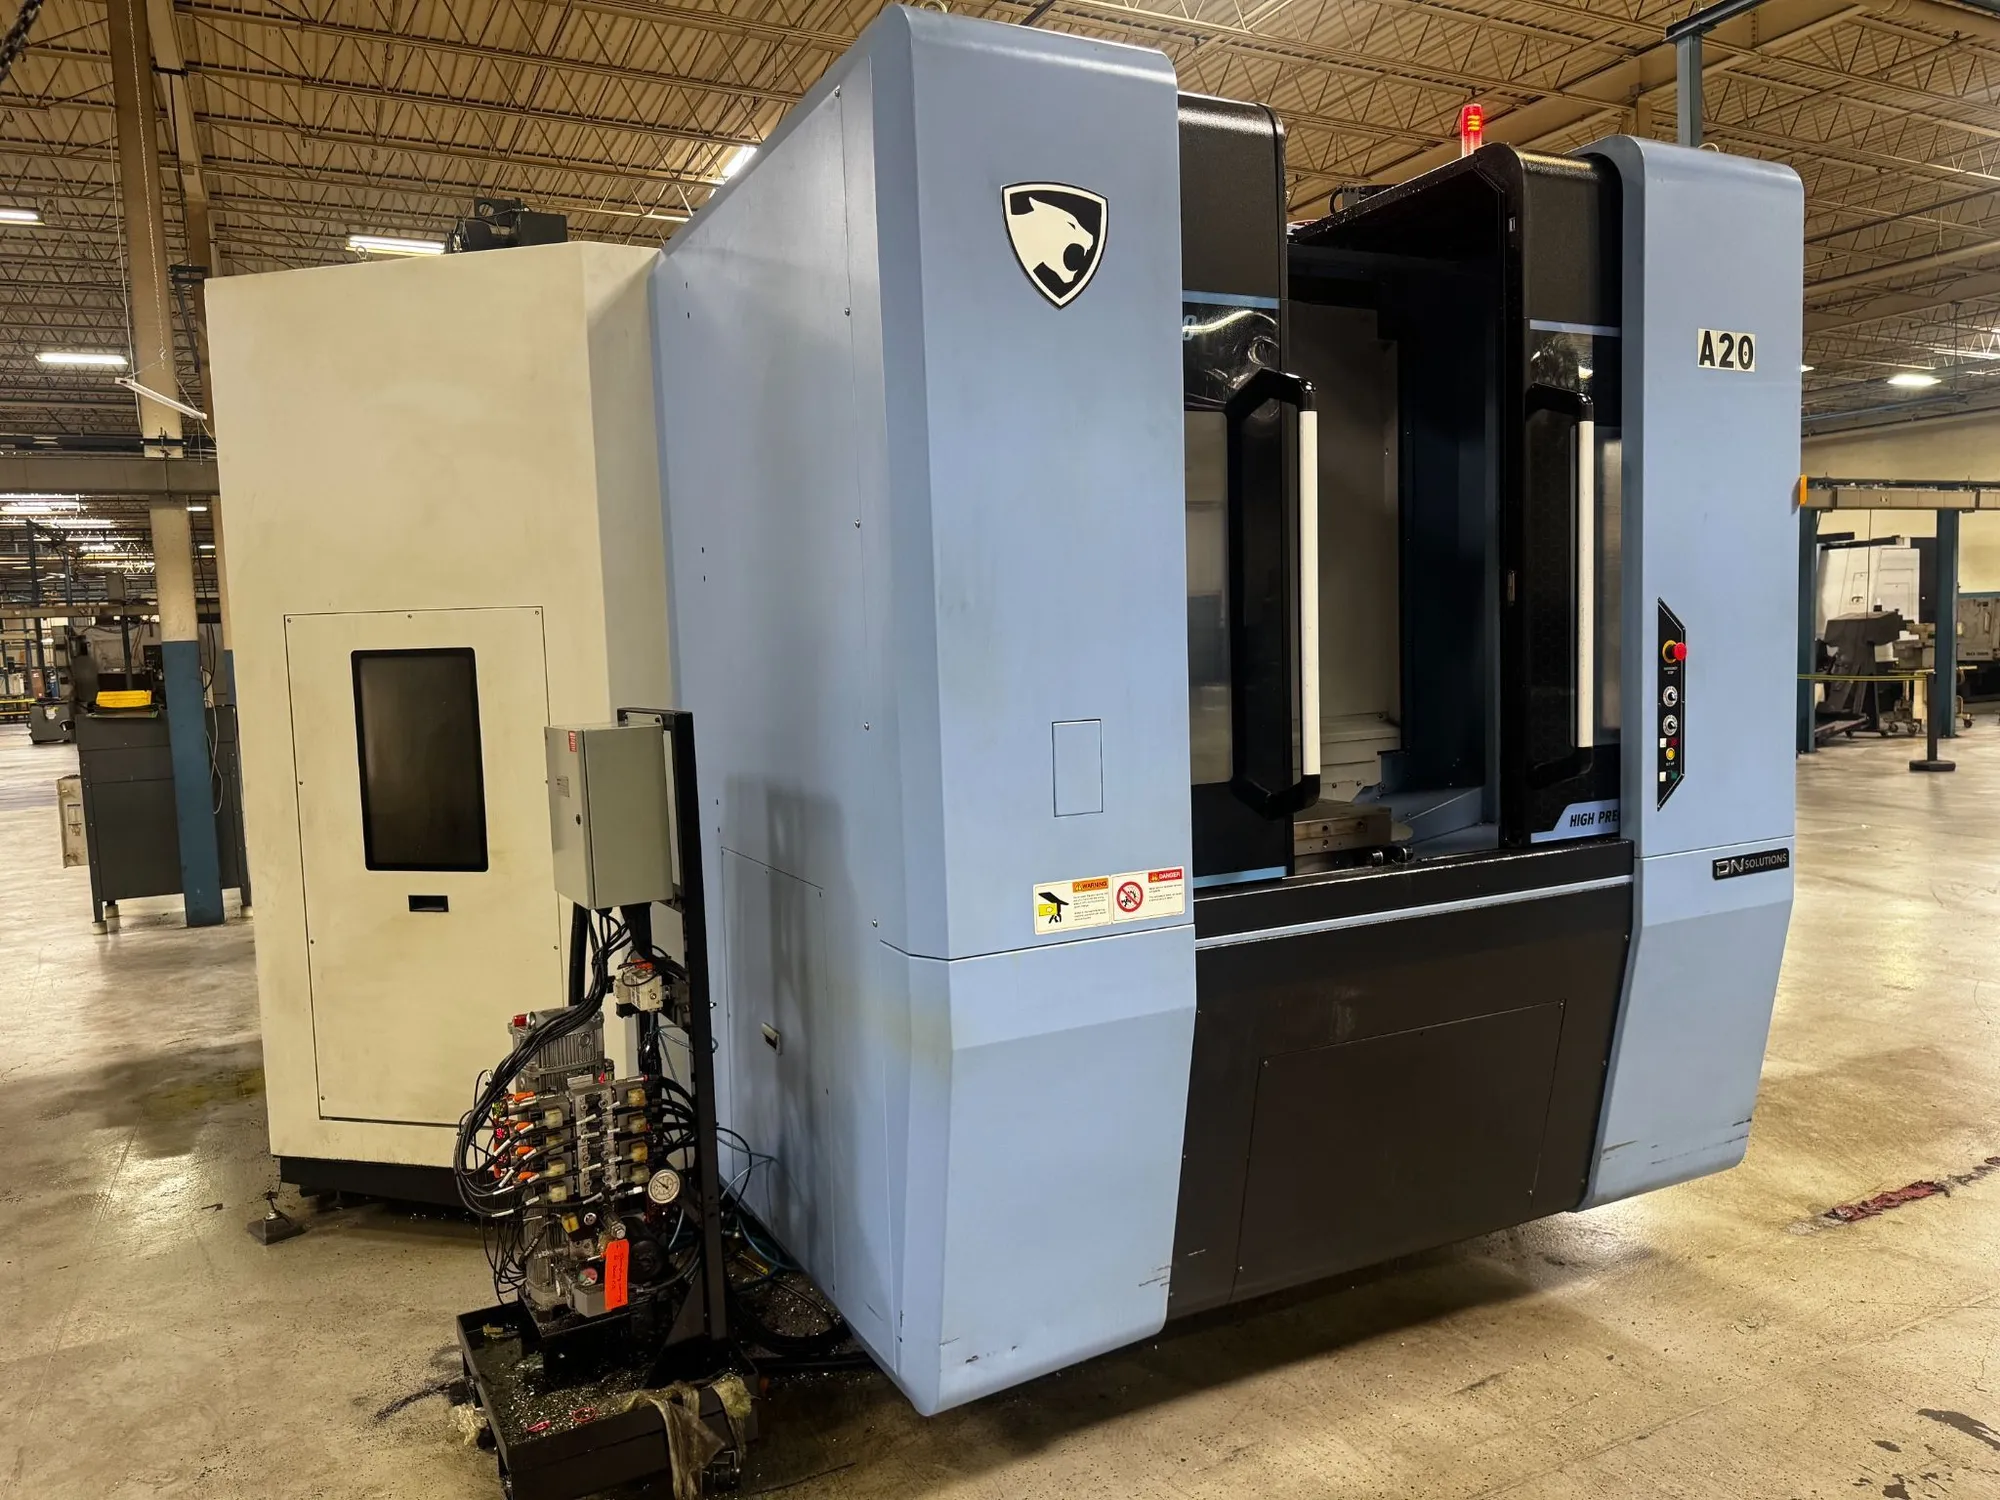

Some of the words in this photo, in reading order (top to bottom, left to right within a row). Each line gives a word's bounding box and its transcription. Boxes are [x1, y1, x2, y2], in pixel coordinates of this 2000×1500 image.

[1699, 330, 1754, 370] A20
[1570, 812, 1595, 828] HIGH
[1716, 858, 1745, 877] DN
[1745, 853, 1787, 869] SOLUTIONS
[1158, 871, 1181, 881] DANGER
[1082, 880, 1108, 890] WARNING
